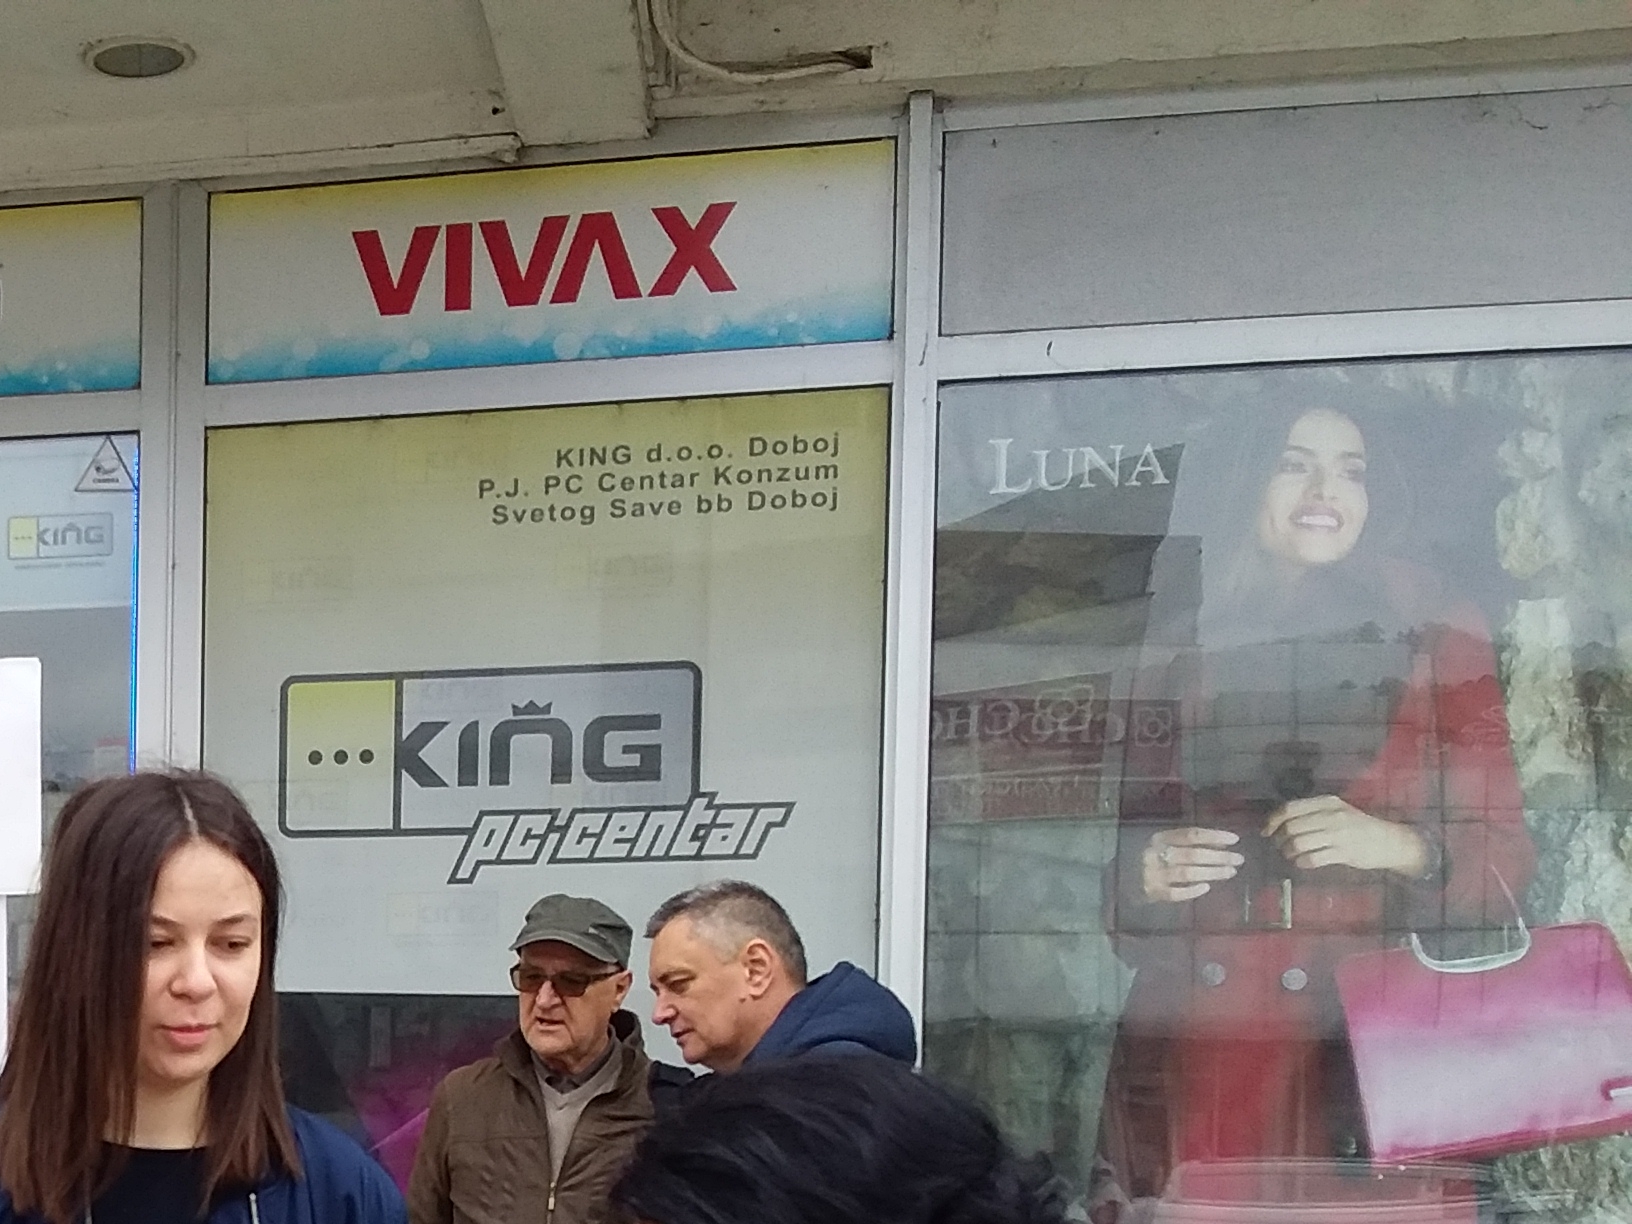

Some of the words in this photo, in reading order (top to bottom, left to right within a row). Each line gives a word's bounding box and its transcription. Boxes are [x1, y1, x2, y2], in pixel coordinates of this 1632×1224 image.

[352, 201, 737, 316] VIVAX
[556, 445, 631, 468] KING
[646, 443, 733, 463] d.o.o.
[748, 432, 839, 457] Doboj
[987, 438, 1170, 494] LUNA
[478, 478, 529, 499] P.J.
[544, 474, 583, 495] PC
[598, 470, 700, 493] Centar
[714, 464, 839, 486] Konzum
[492, 502, 596, 526] Svetog
[609, 498, 682, 519] Save
[696, 494, 733, 514] bb
[747, 487, 839, 512] Doboj
[37, 527, 105, 548] KING
[401, 713, 662, 788] KING
